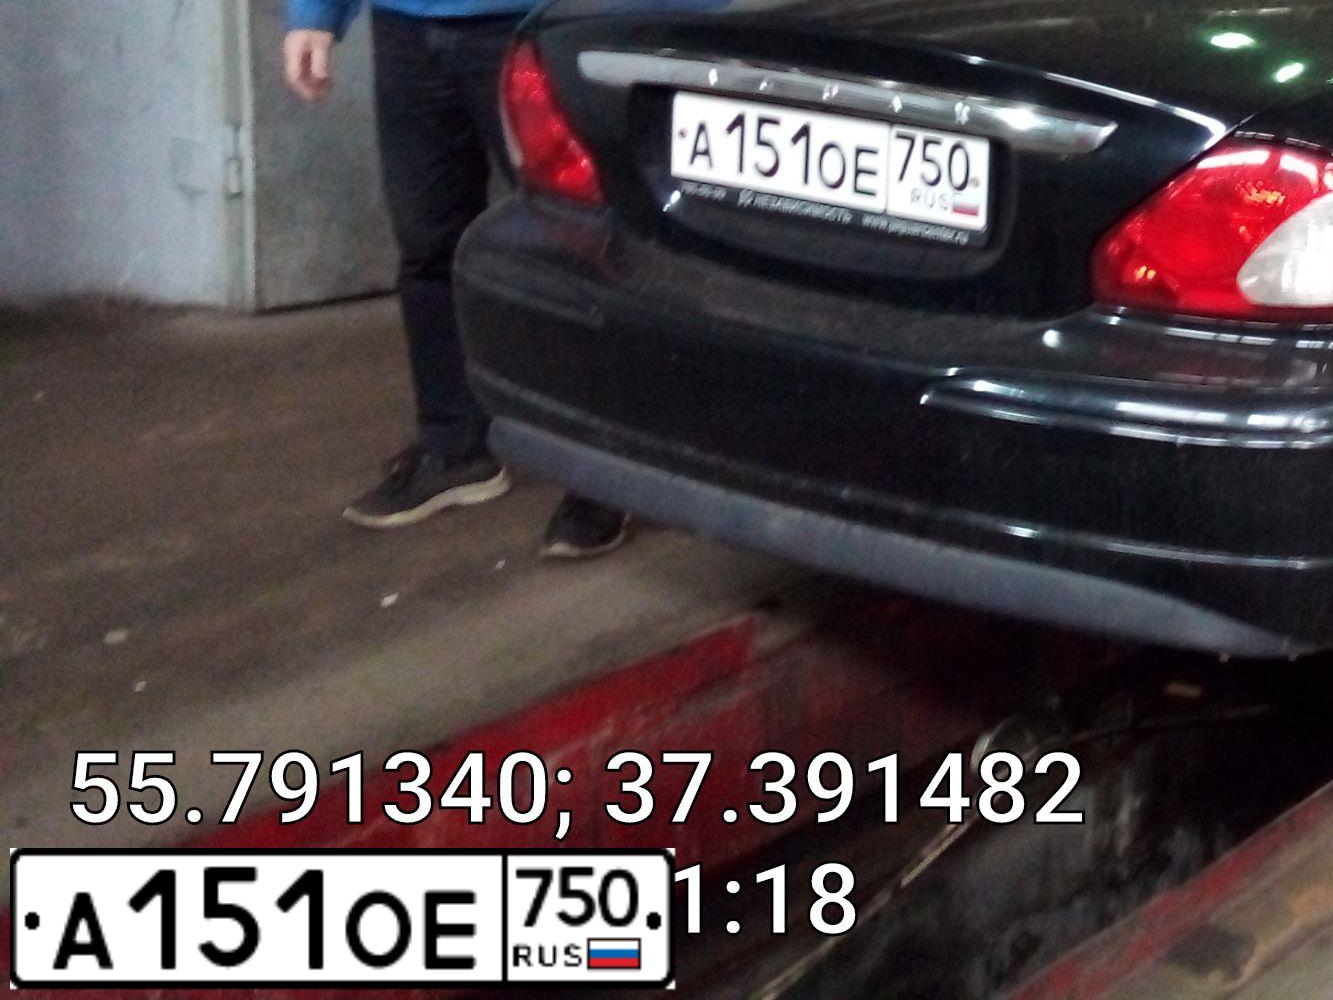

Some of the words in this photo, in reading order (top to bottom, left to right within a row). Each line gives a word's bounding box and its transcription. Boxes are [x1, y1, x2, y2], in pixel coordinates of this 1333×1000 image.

[690, 112, 878, 197] А151ОЕ
[896, 133, 970, 192] 750
[911, 187, 949, 212] RUS
